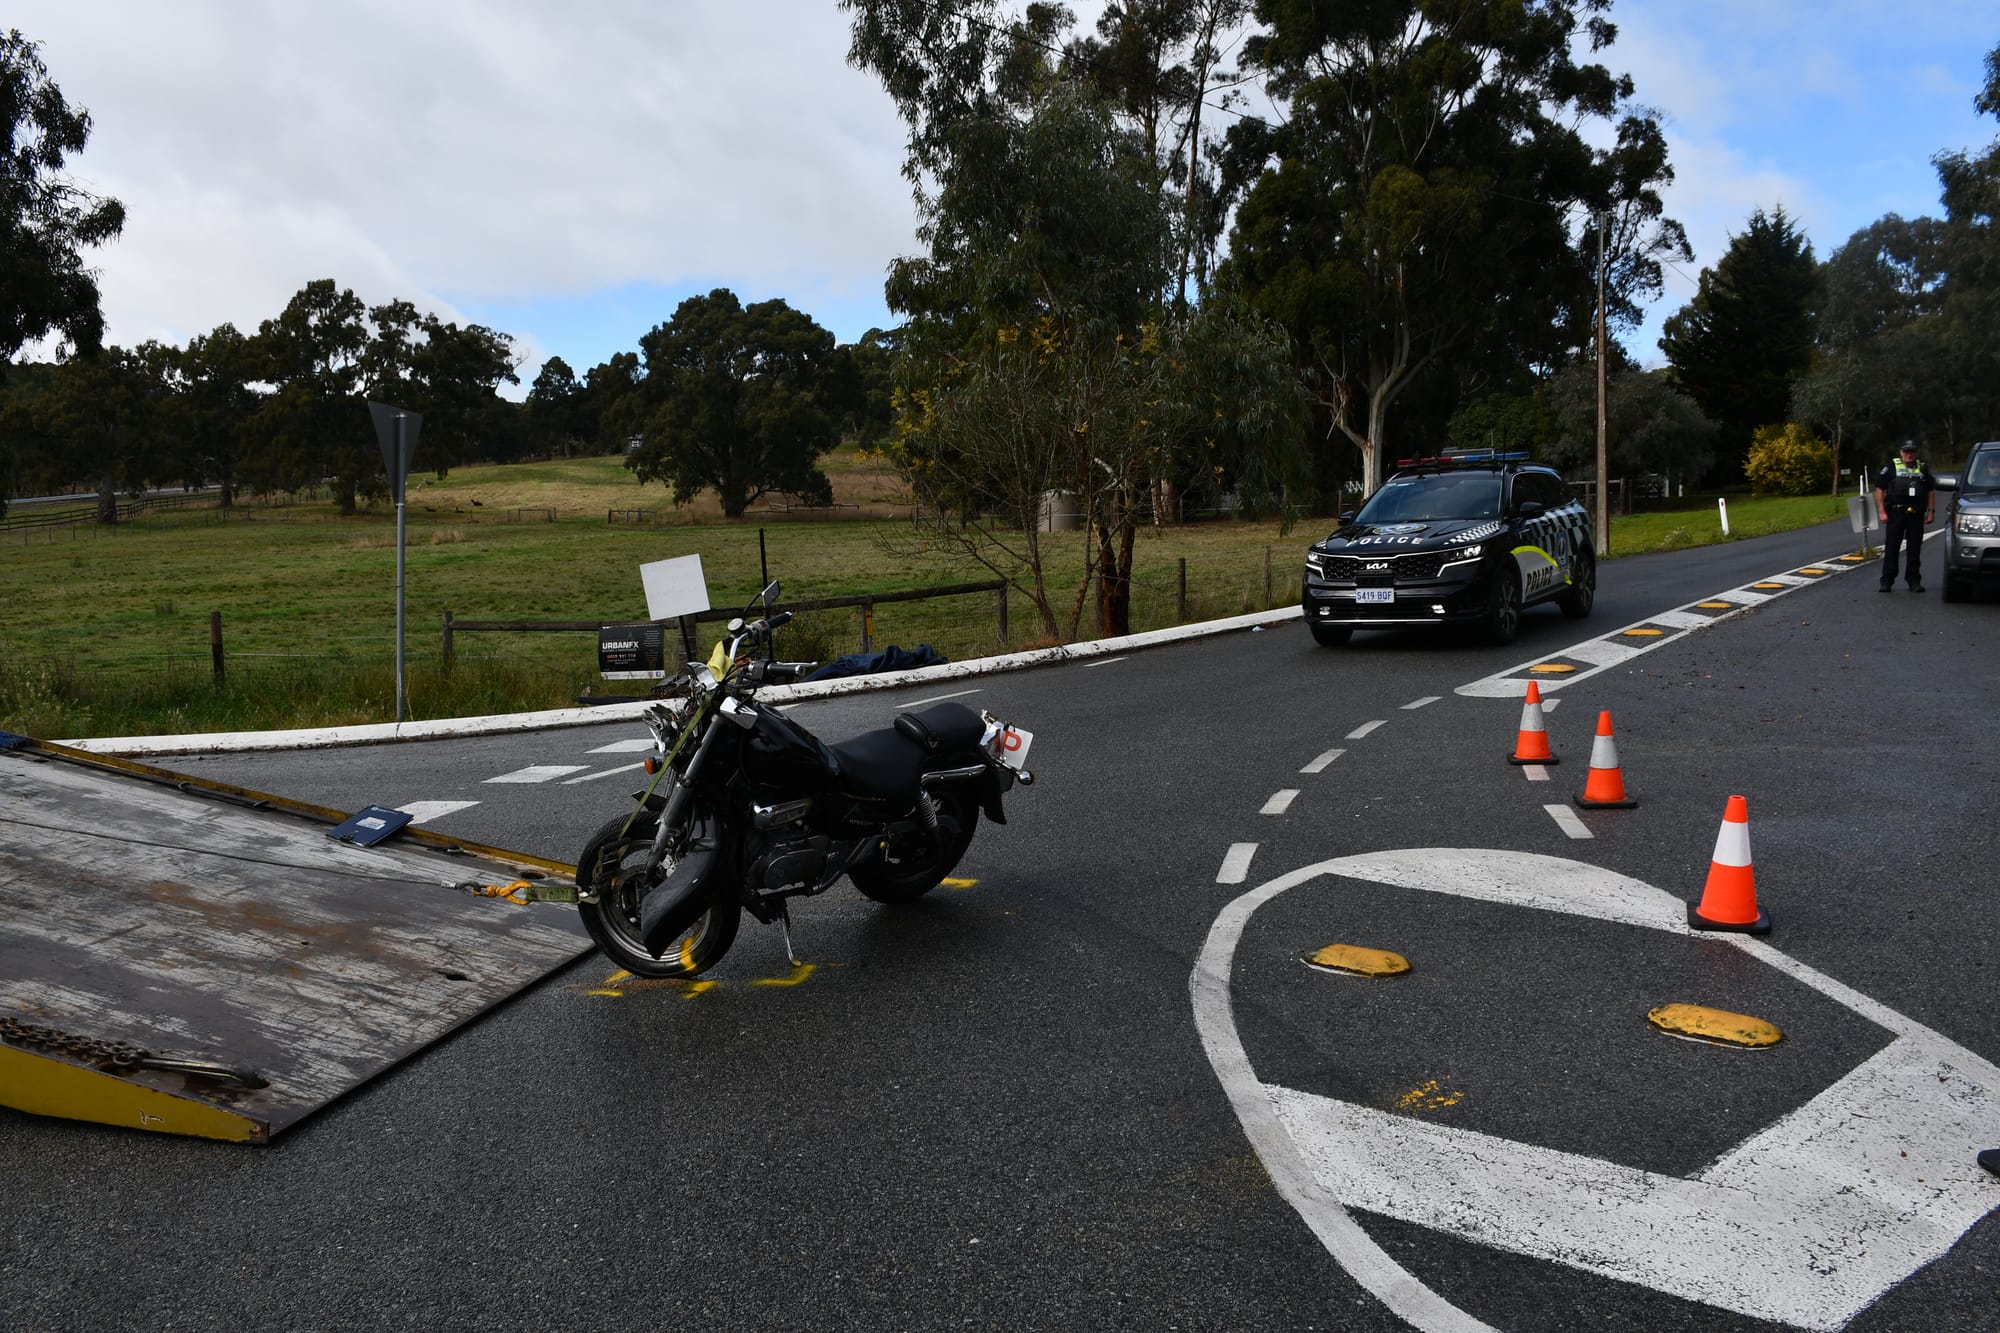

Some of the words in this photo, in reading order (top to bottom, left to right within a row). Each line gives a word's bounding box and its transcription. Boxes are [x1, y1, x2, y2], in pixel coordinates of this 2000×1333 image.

[1345, 537, 1424, 547] POLICE
[1526, 566, 1553, 592] POLICE
[1357, 591, 1374, 600] S419
[602, 641, 639, 649] URBANFX
